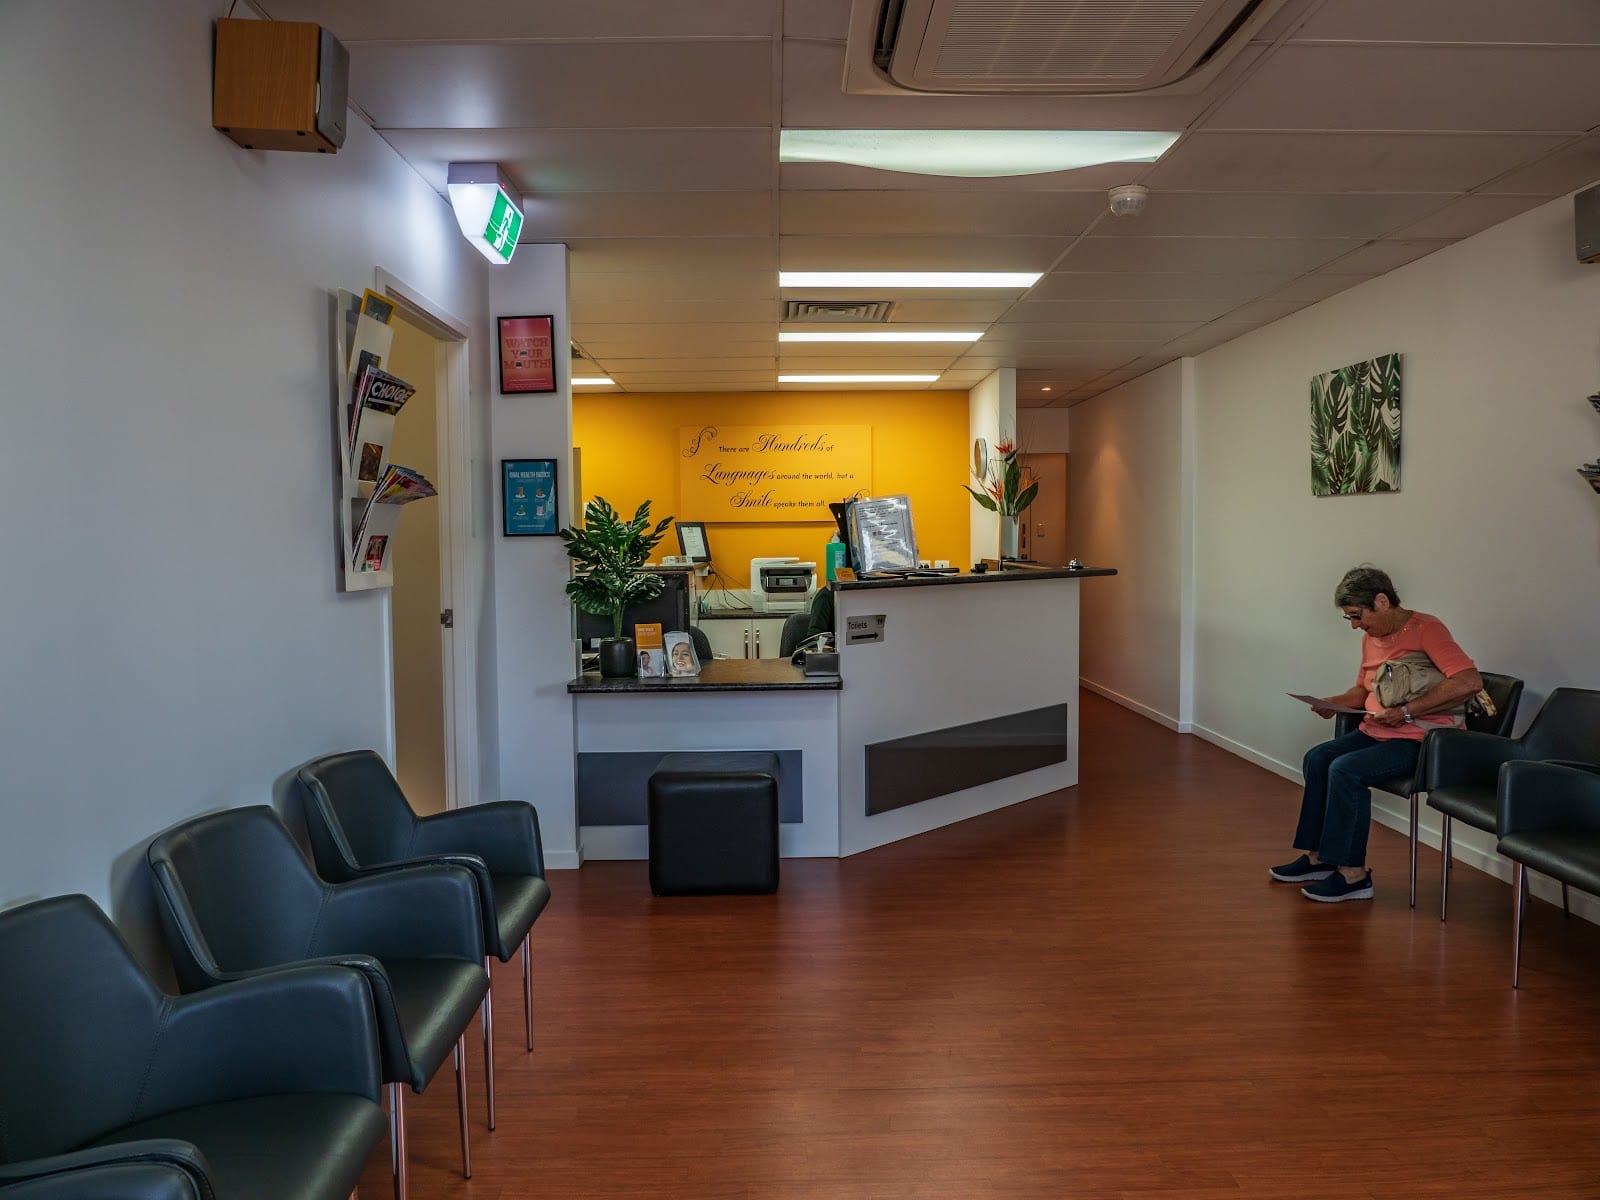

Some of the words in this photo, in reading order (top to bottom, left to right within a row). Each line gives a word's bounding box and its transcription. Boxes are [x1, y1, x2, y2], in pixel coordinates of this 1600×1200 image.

[371, 381, 413, 403] CHOICE
[752, 433, 828, 453] Hundreds
[699, 462, 777, 486] Languages
[776, 472, 800, 480] around
[802, 472, 813, 480] the
[729, 489, 776, 508] Smile
[773, 500, 796, 509] speaks
[847, 617, 868, 630] Toilets
